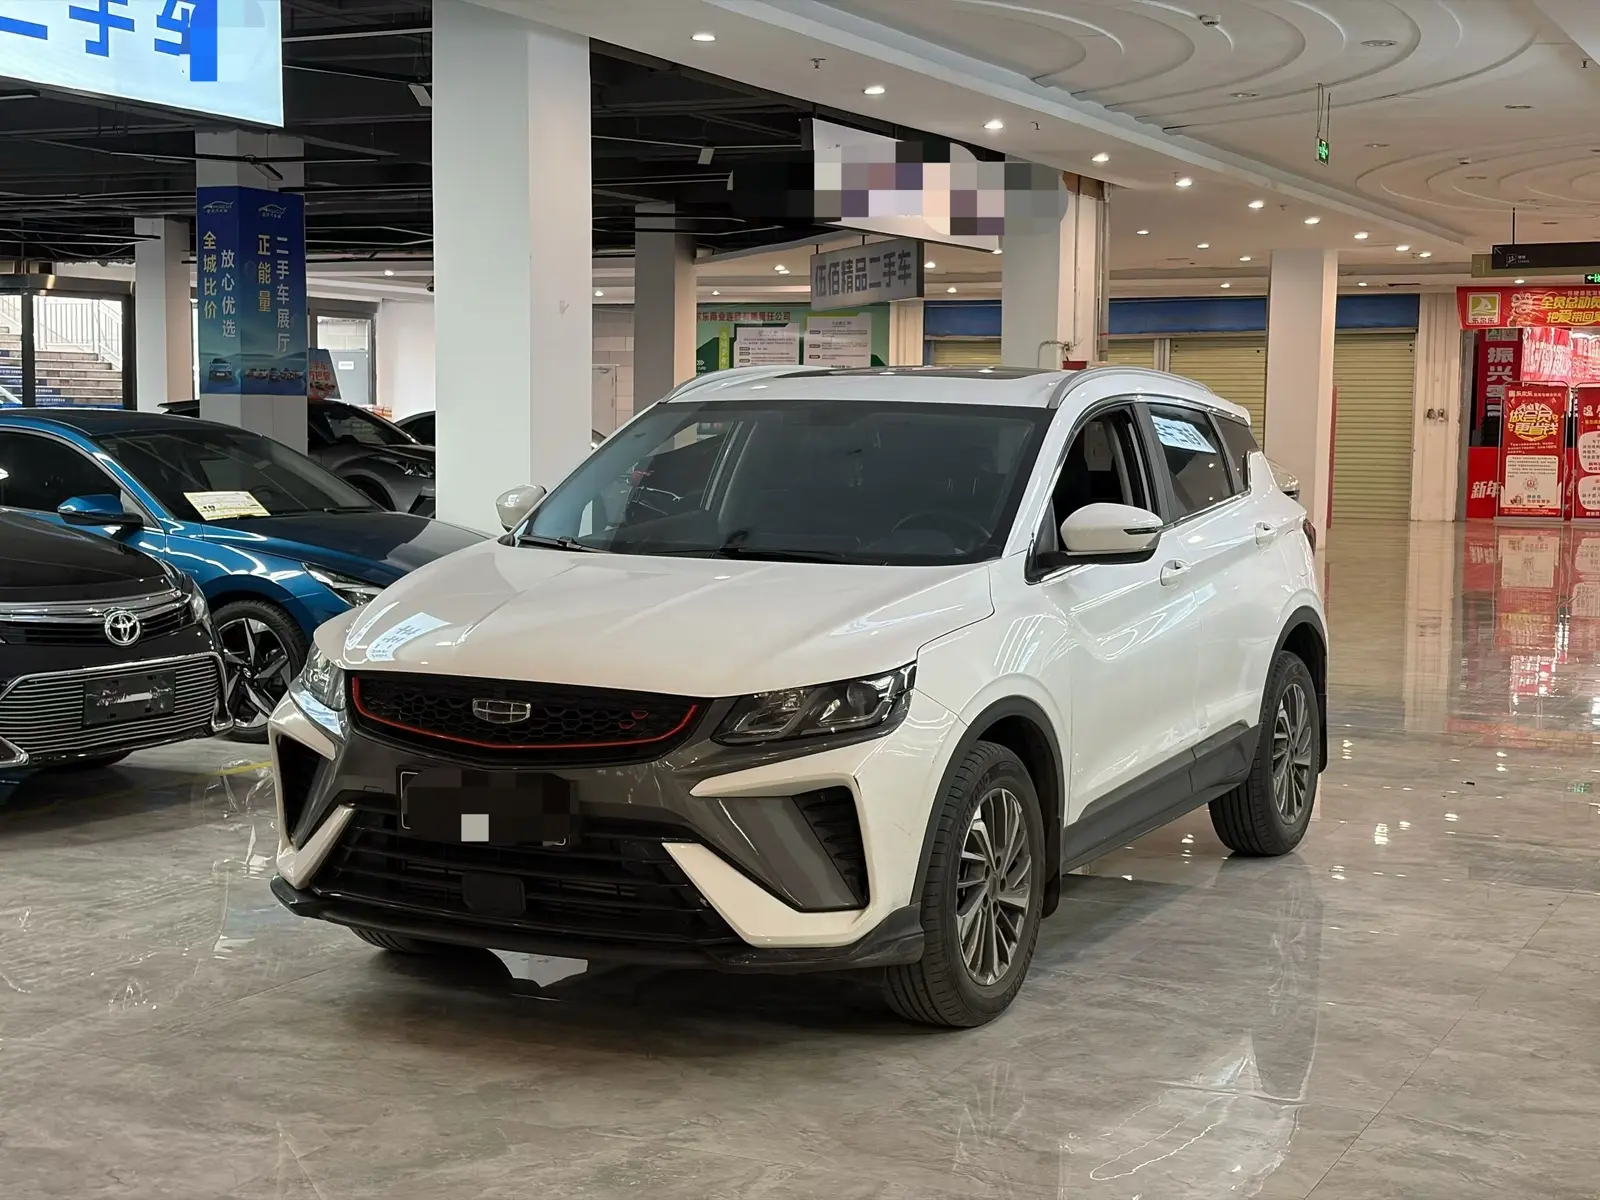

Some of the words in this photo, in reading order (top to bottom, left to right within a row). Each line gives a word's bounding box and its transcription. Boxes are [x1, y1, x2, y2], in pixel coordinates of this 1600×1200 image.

[203, 231, 217, 319] 全城比价
[221, 249, 236, 338] 放心优选
[258, 235, 271, 312] 正能量
[276, 236, 290, 352] 二手车展厅
[815, 250, 912, 297] 伍佰精品二手车
[1509, 408, 1553, 423] 做会员
[1513, 422, 1559, 436] 更省钱
